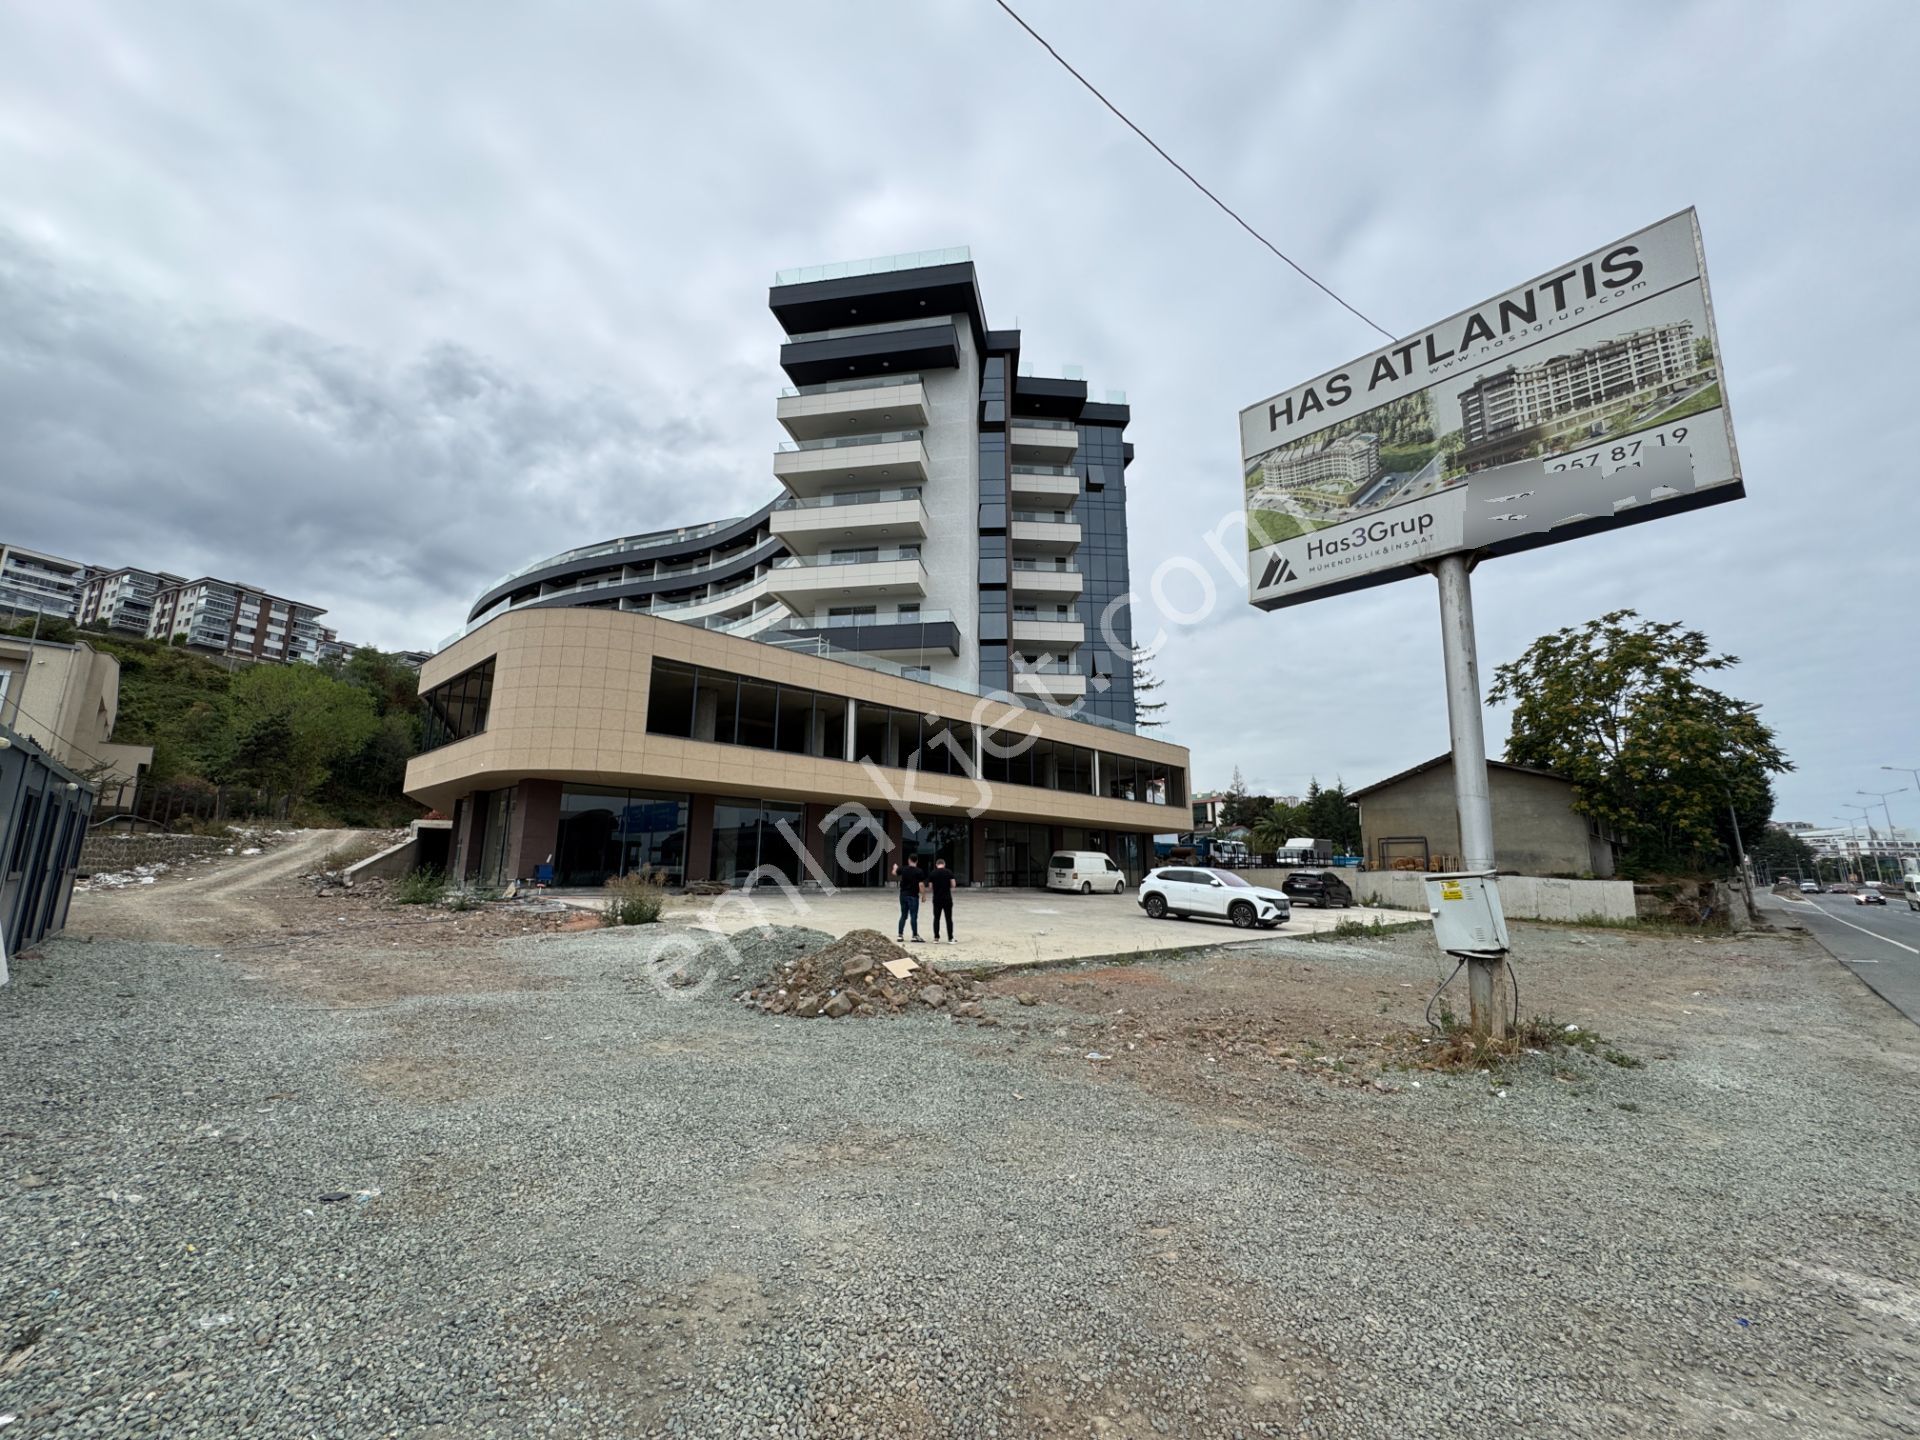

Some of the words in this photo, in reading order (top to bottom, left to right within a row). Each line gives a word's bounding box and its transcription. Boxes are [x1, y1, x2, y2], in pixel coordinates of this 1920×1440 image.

[1269, 373, 1352, 432] HAS
[1368, 245, 1643, 392] ATLANTIS
[1611, 440, 1642, 461] 87
[1656, 427, 1688, 447] 19
[1307, 513, 1434, 560] Has3Grup
